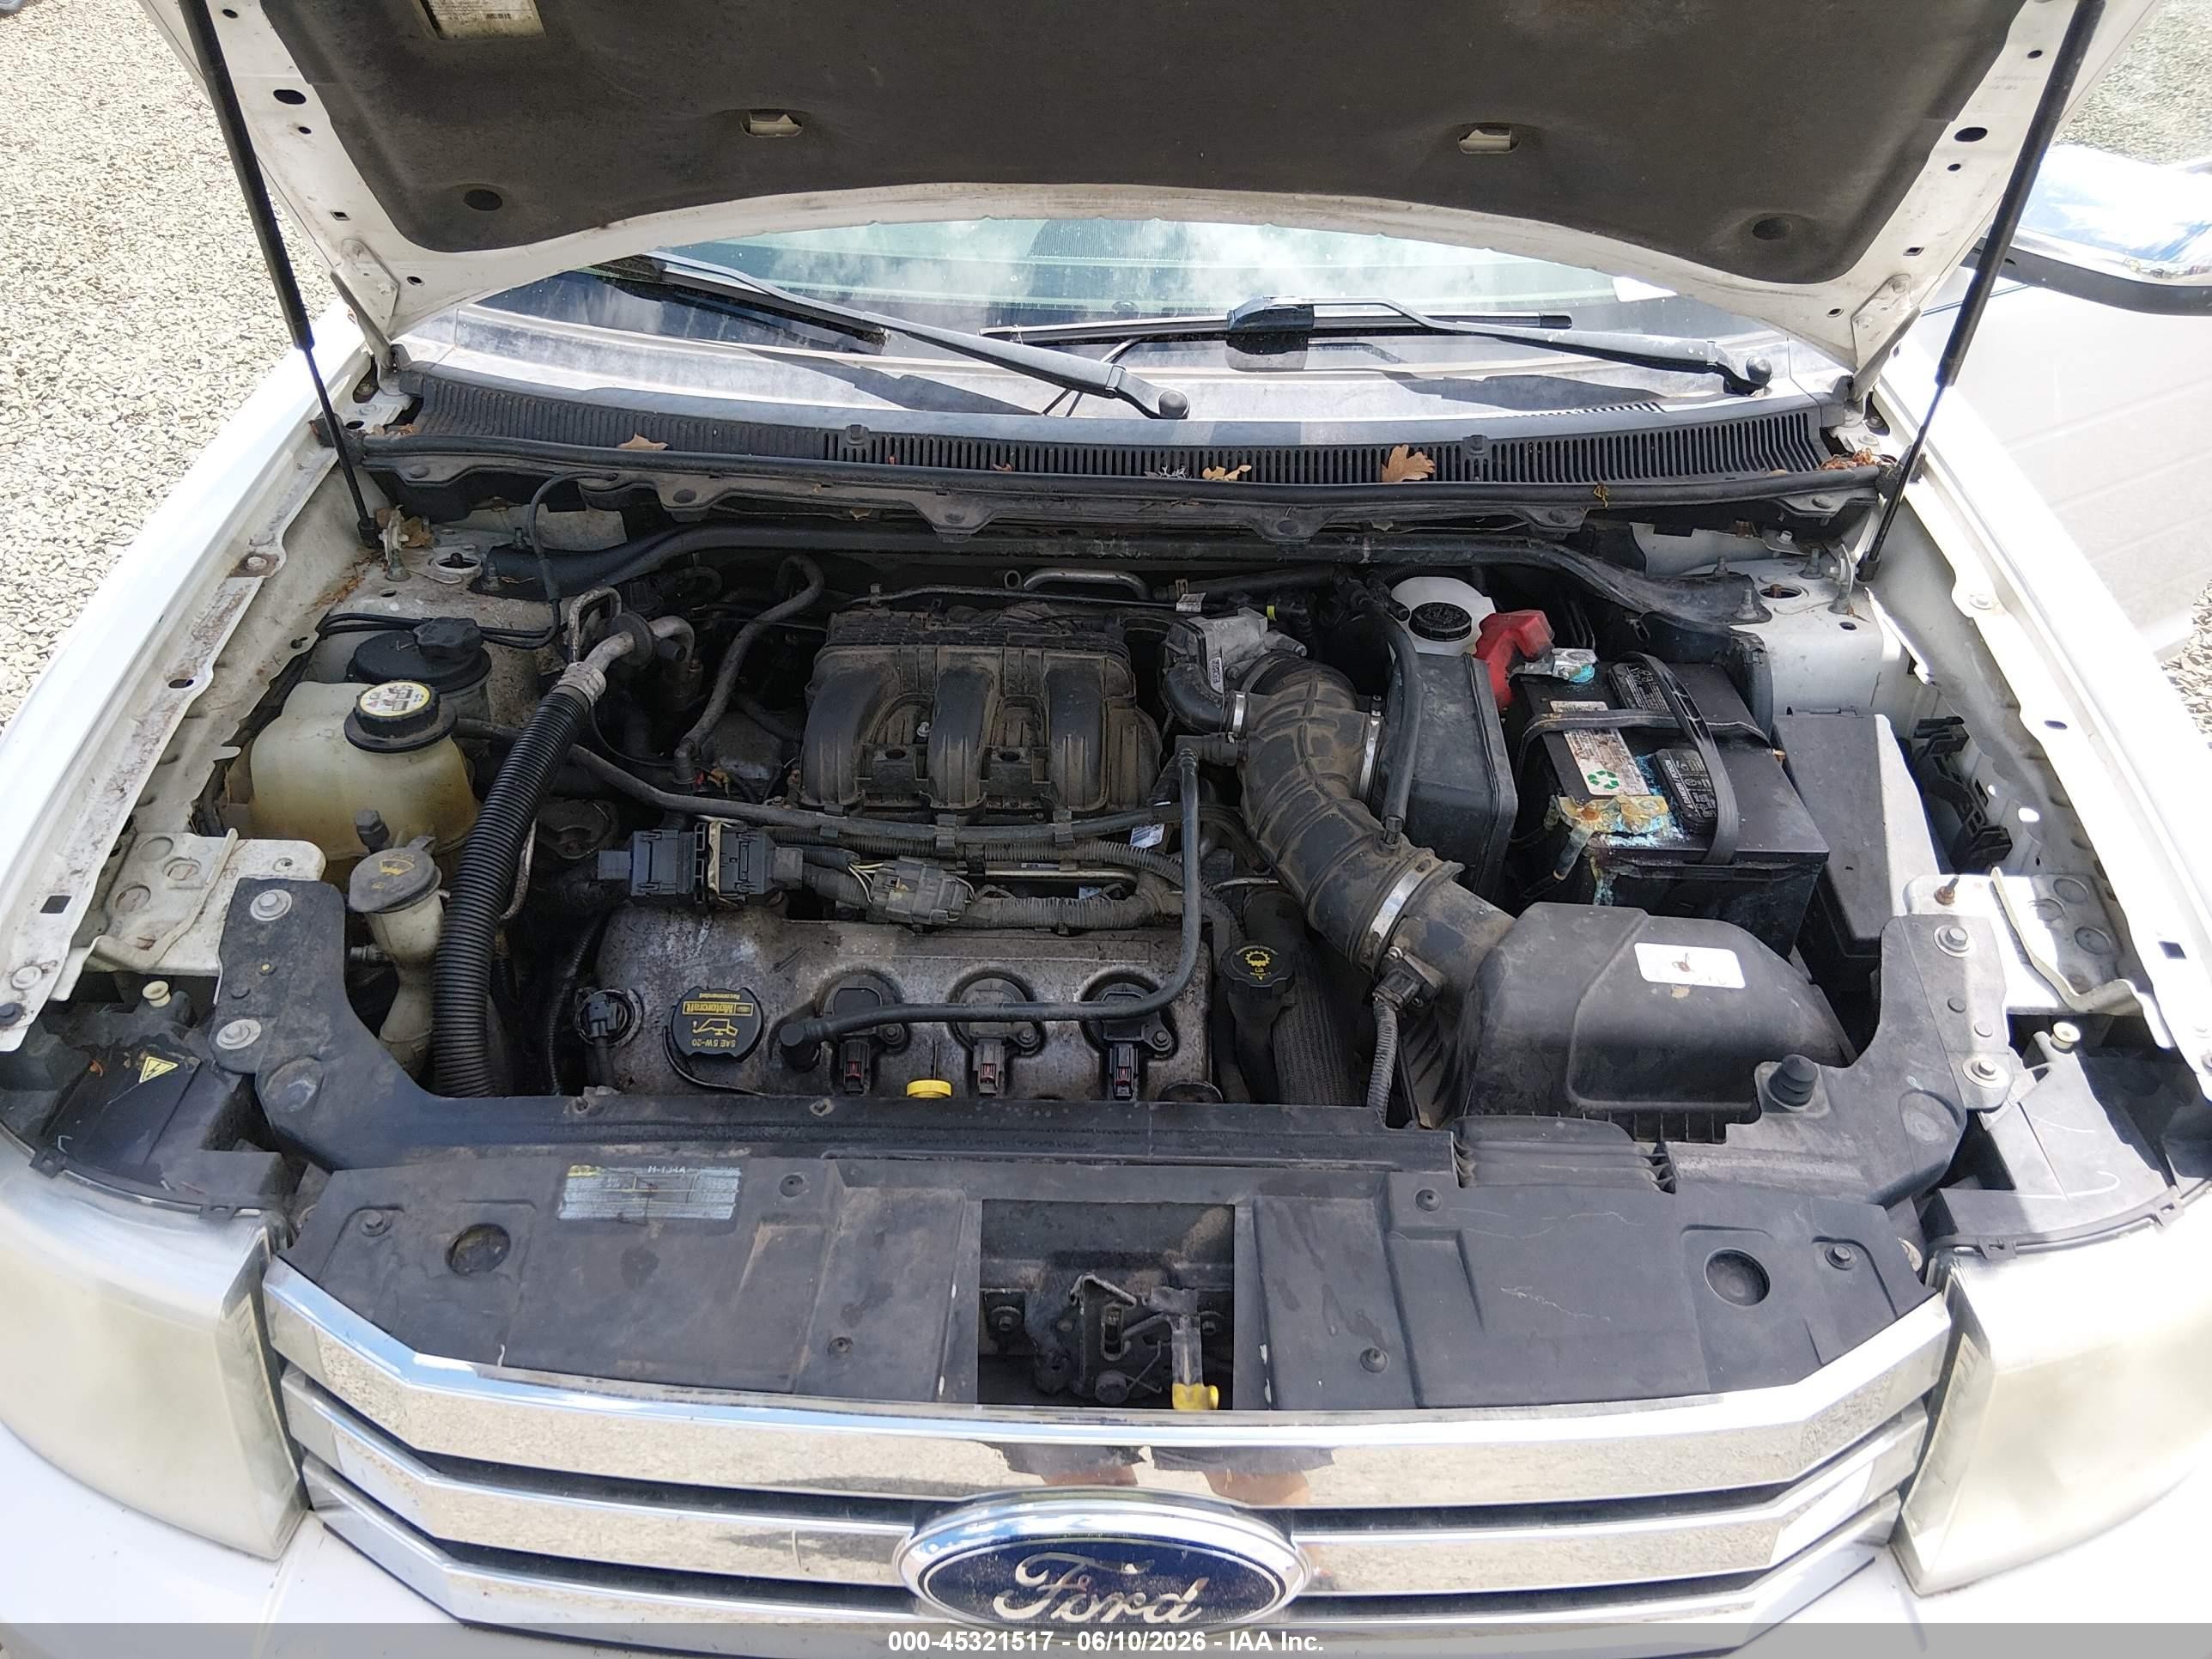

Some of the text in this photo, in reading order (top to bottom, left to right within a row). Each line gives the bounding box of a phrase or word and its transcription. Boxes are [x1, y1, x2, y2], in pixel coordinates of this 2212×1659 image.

[686, 1002, 734, 1014] Motorcraft
[691, 1038, 737, 1048] SAE 5W-20
[993, 1552, 1210, 1625] Ford
